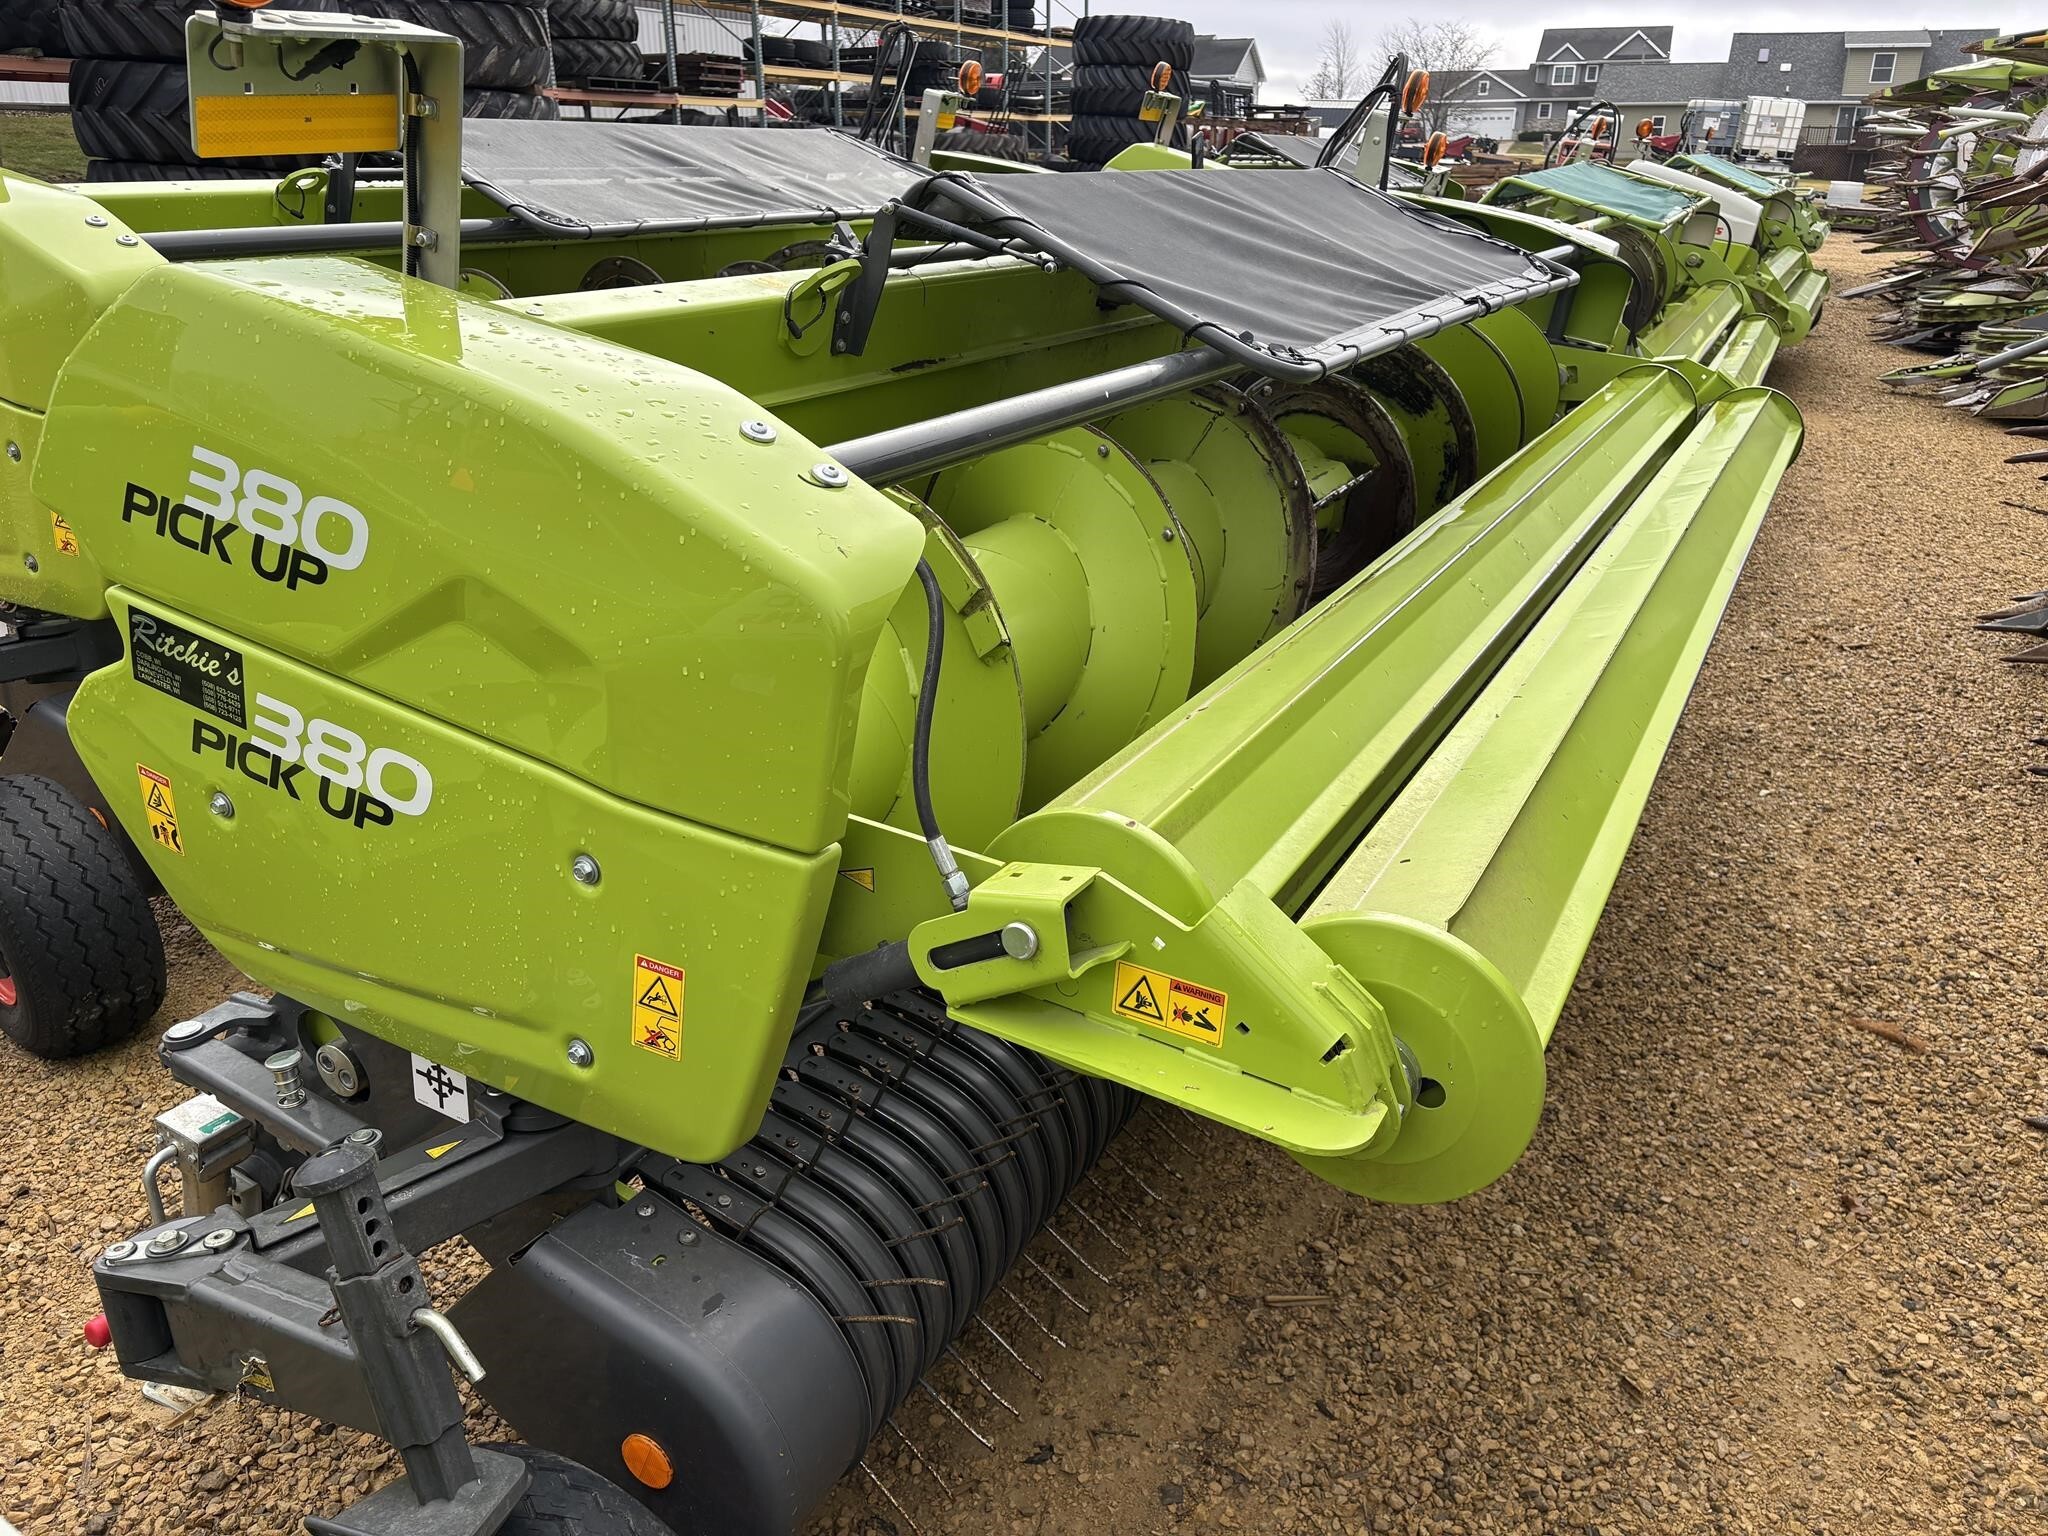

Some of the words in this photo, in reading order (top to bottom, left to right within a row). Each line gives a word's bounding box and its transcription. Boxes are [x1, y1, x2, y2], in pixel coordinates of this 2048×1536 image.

[122, 482, 239, 565] PICK
[251, 533, 329, 591] UP
[184, 444, 369, 571] 380
[131, 614, 242, 685] Ritchie's
[191, 718, 306, 801] PICK
[318, 775, 394, 830] UP
[250, 692, 433, 816] 380
[649, 962, 680, 978] DANGER
[1182, 984, 1221, 1003] WARNING
